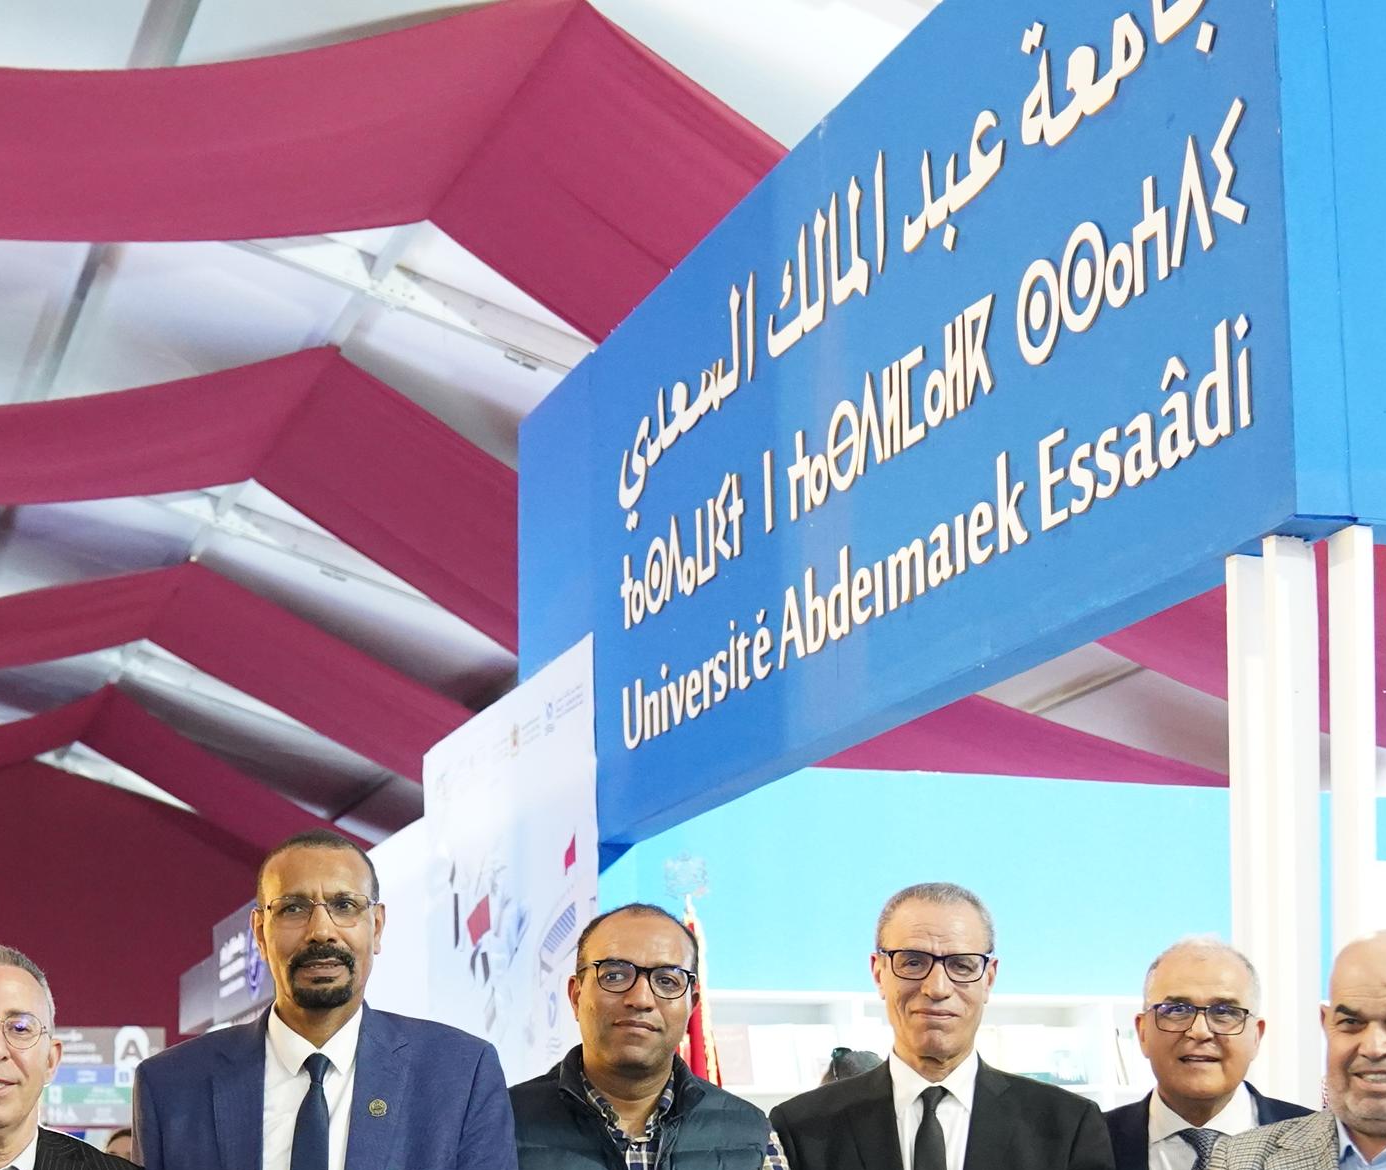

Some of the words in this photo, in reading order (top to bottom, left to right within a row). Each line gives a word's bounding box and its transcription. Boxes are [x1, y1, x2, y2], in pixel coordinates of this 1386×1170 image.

[767, 149, 886, 357] المالك
[902, 110, 1006, 252] عبد
[618, 271, 755, 531] السعدي
[621, 608, 773, 750] Université
[1038, 313, 1253, 532] Essaâdi
